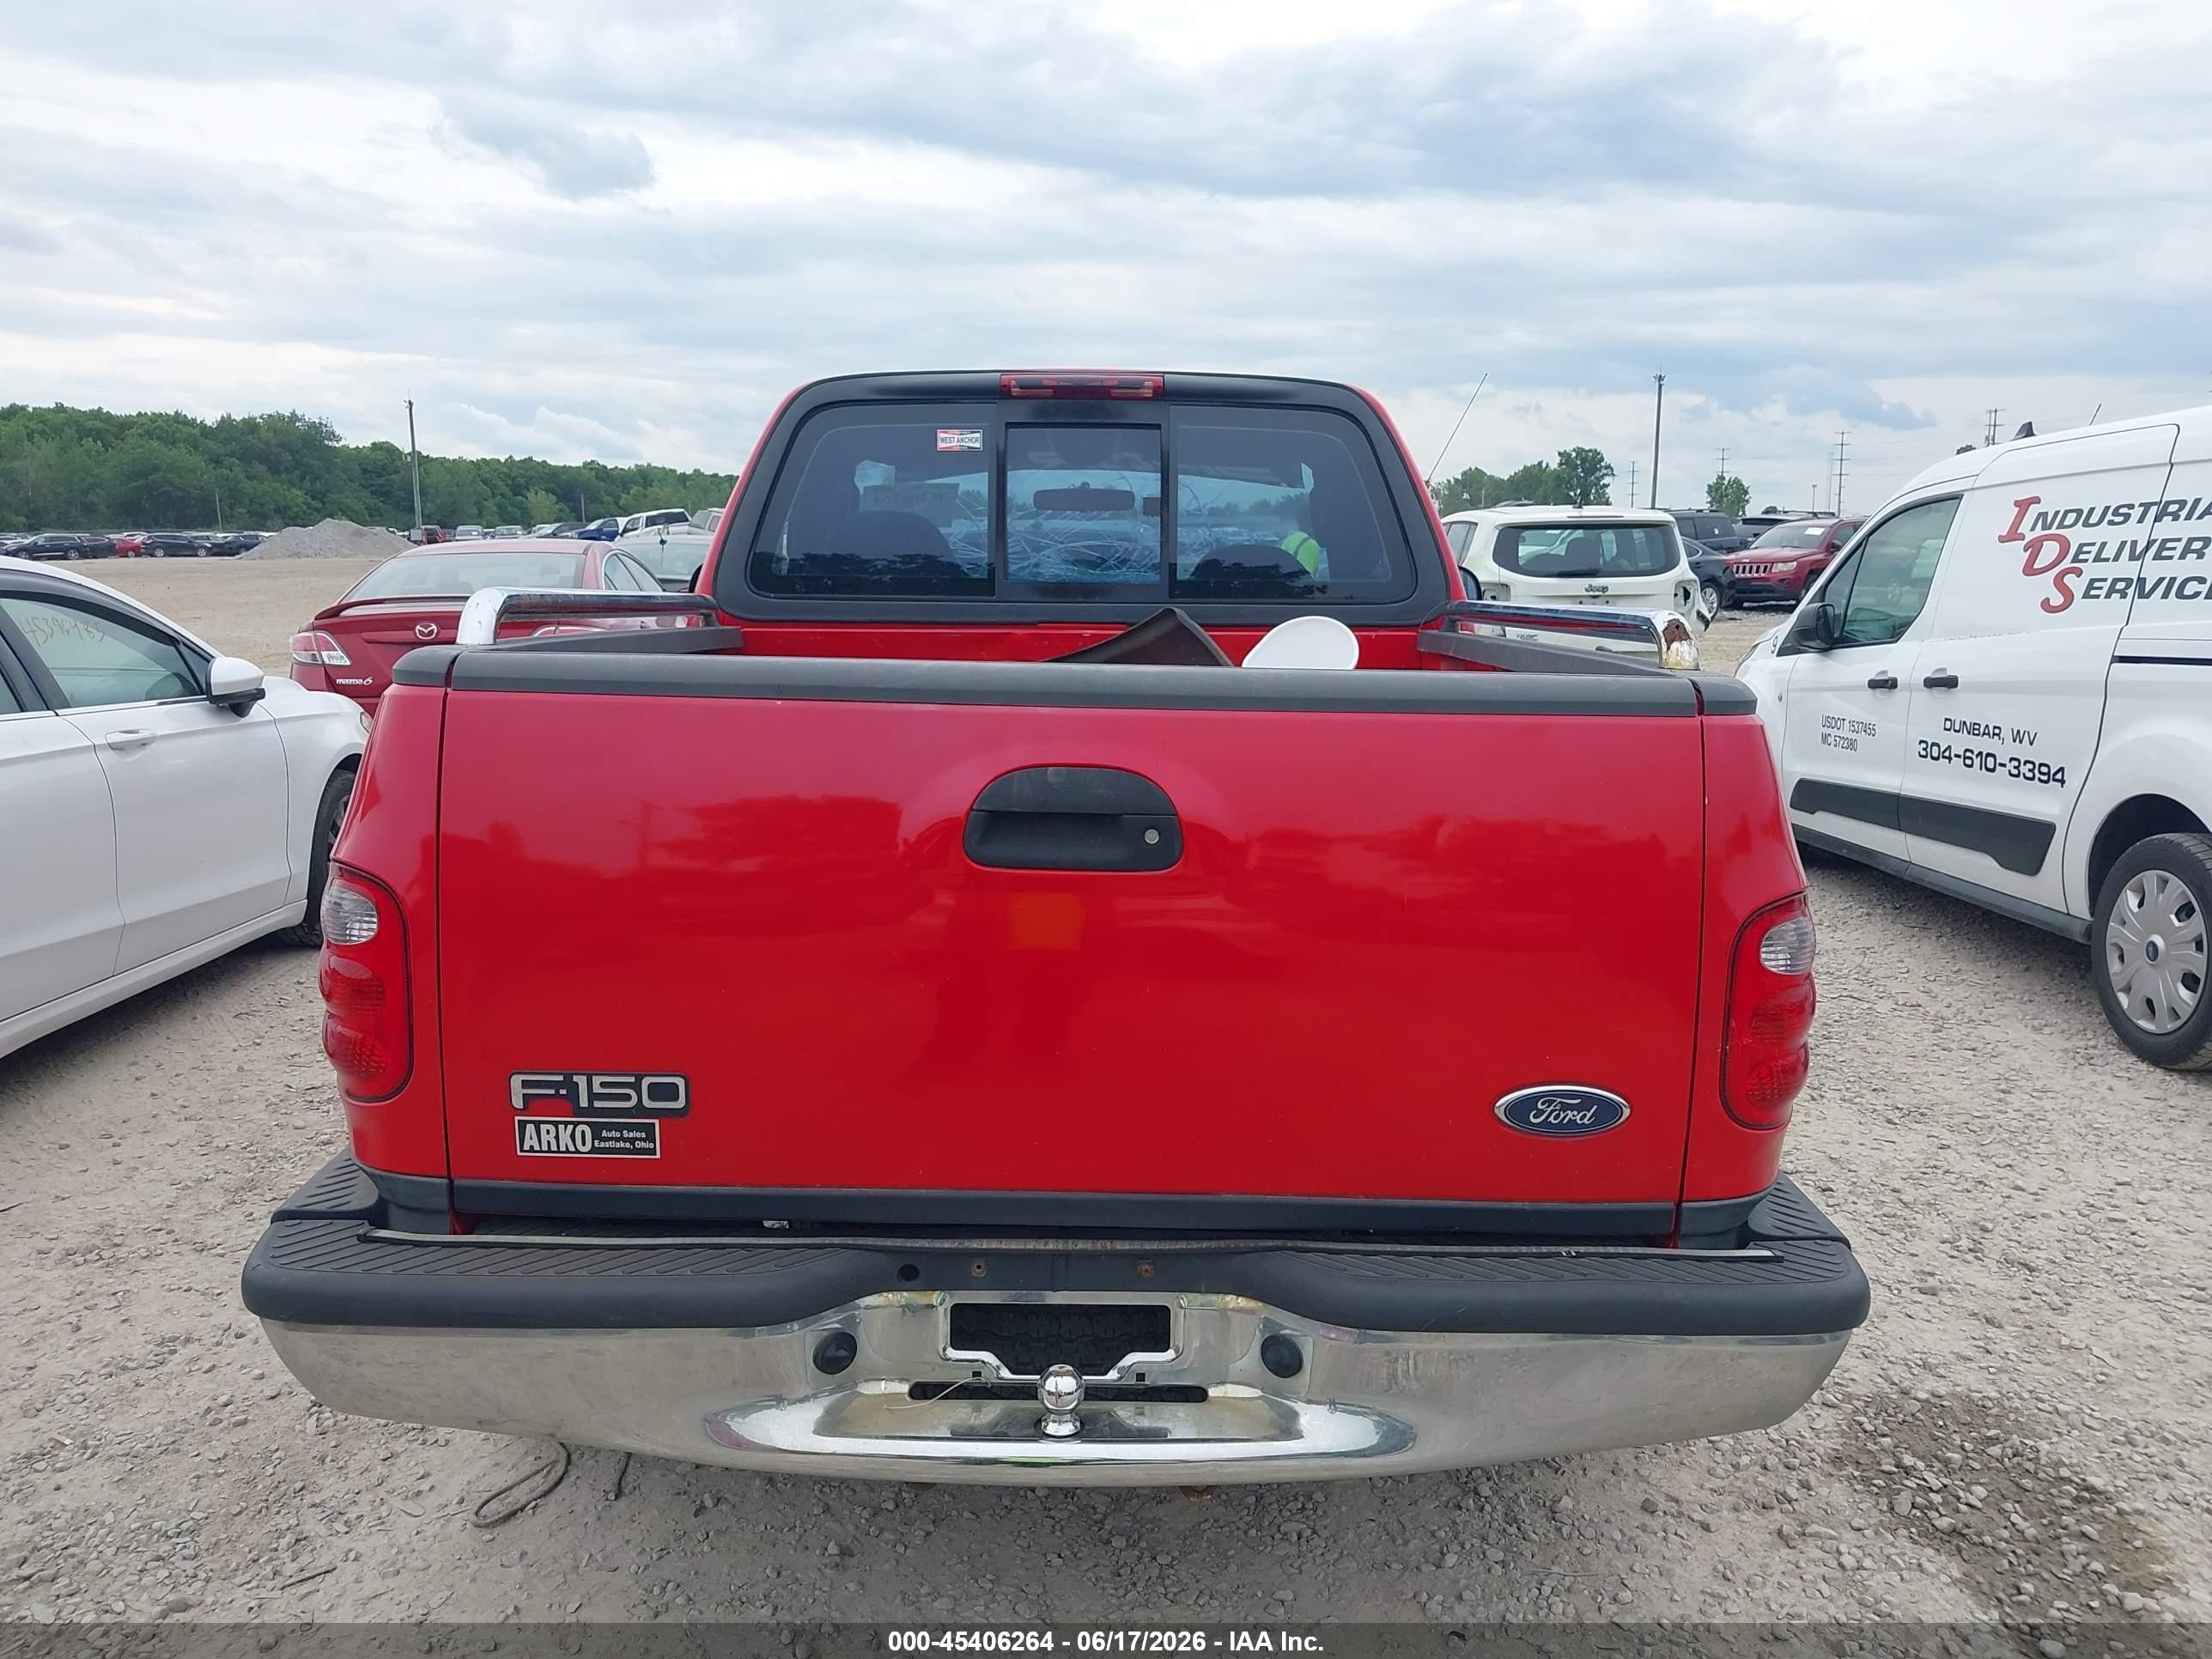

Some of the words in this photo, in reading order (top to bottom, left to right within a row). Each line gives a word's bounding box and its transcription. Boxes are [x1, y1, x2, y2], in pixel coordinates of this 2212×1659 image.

[1584, 584, 1609, 593] Jeep
[1821, 714, 1846, 731] USDOT
[1848, 720, 1876, 737] 1537455
[1943, 717, 2005, 745] DUNBAR,
[2011, 727, 2038, 746] WV
[1821, 732, 1832, 746] MC
[1833, 735, 1858, 752] 572380
[1917, 739, 2066, 788] 304-610-3394
[510, 1073, 686, 1109] F-150
[1529, 1097, 1598, 1125] Ford
[523, 1123, 592, 1152] ARKO
[594, 1140, 633, 1150] Eastlake,
[635, 1139, 654, 1149] Ohio
[601, 1129, 621, 1138] Auto
[623, 1129, 646, 1139] Sales
